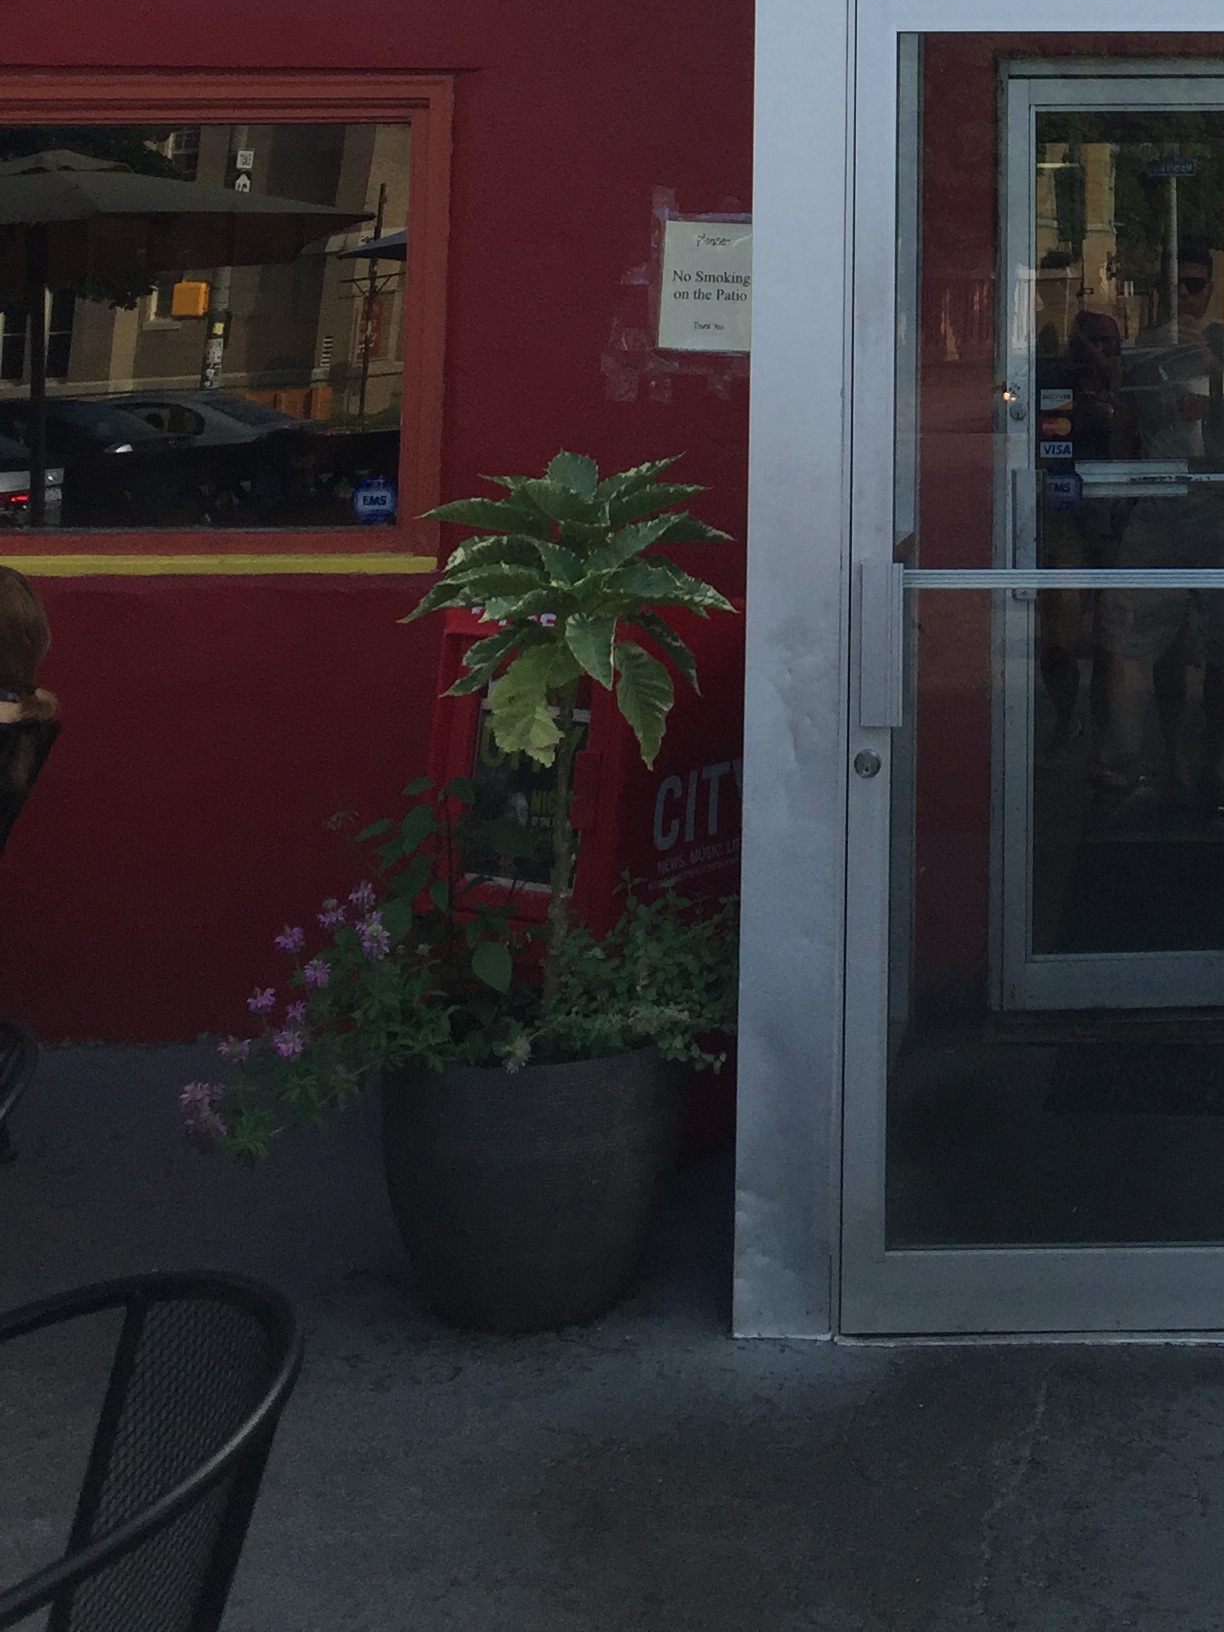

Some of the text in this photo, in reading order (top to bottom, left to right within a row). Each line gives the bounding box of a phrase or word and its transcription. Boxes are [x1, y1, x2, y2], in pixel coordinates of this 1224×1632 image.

[672, 270, 751, 287] No Smoking
[673, 288, 748, 302] on the Patio
[1043, 444, 1071, 455] VISA
[363, 495, 387, 506] EMS
